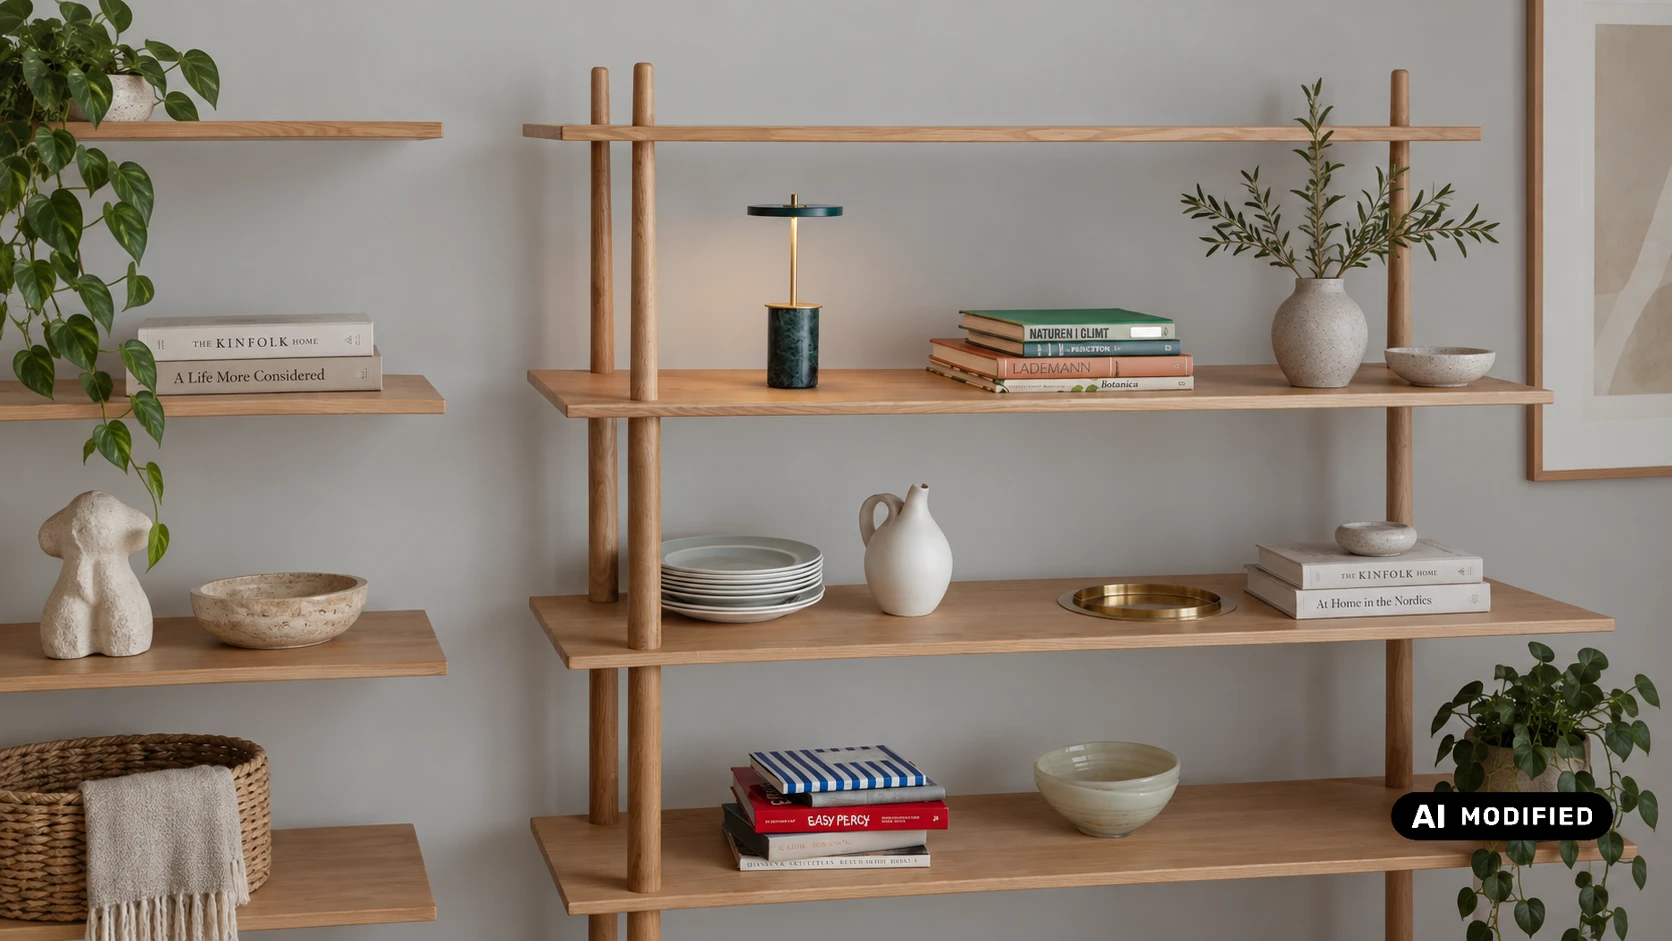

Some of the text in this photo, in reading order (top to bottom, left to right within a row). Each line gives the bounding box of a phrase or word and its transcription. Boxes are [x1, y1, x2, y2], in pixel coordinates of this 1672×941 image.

[1030, 327, 1074, 340] NATUREN
[1080, 327, 1109, 339] GLIMT
[192, 337, 319, 349] THE KINFOLK HOME
[1013, 361, 1091, 375] LADEMANN
[174, 368, 325, 384] A Life More Considered
[1101, 379, 1139, 389] Botanica
[1358, 569, 1414, 580] KINFOLK
[1316, 595, 1432, 609] At Home in the Nordics
[808, 815, 835, 827] EASY
[837, 814, 871, 827] PERCY
